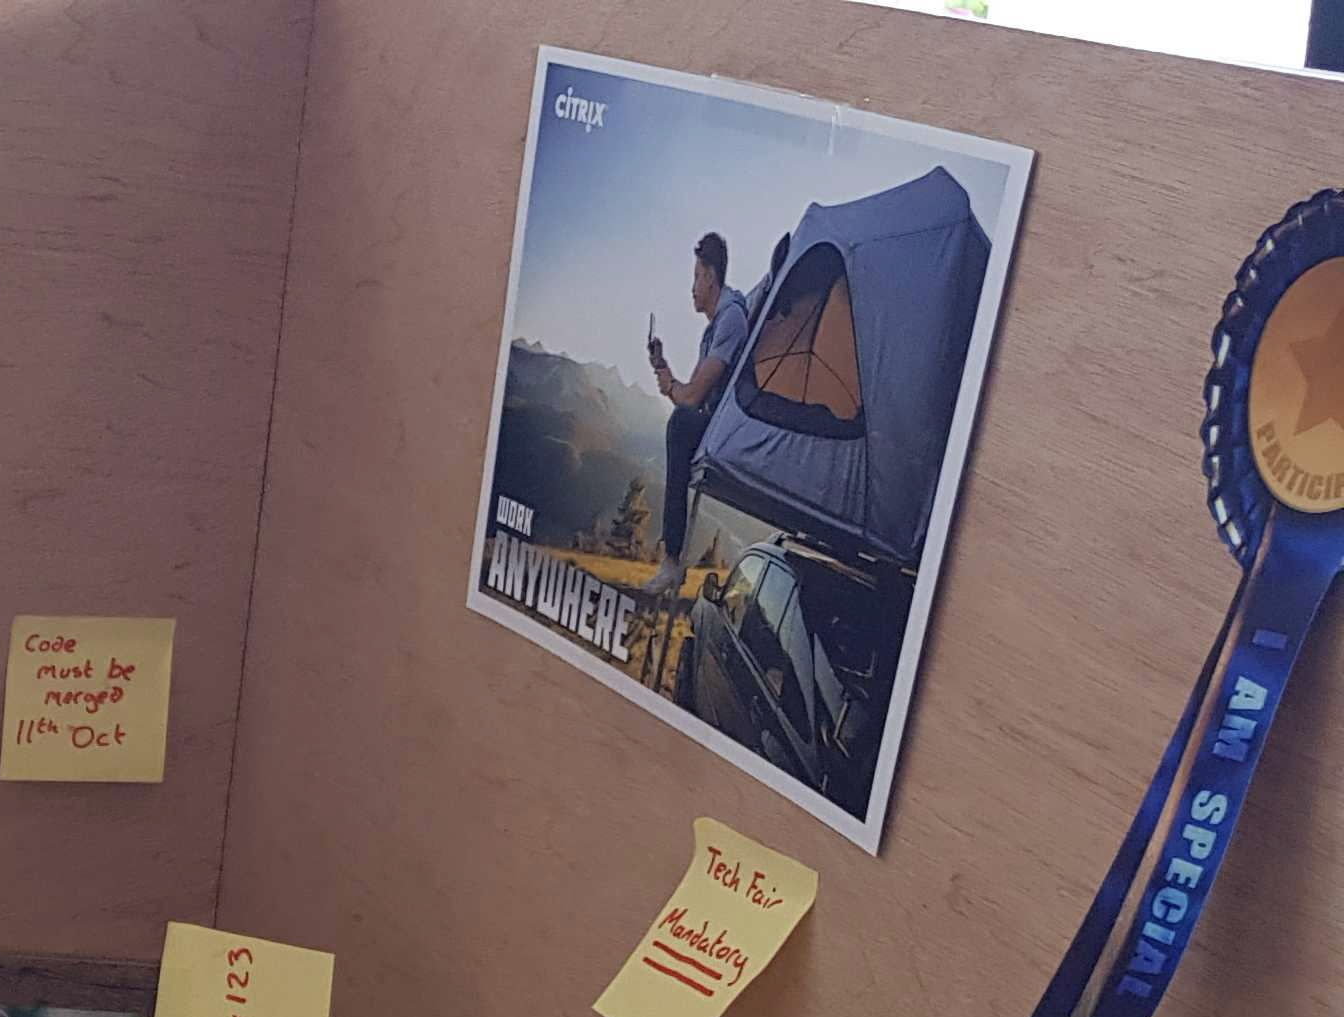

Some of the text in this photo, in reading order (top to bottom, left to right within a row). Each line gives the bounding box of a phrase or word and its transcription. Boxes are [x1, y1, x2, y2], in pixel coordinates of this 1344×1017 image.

[496, 495, 535, 537] WORK
[487, 530, 637, 663] ANYWHERE
[25, 634, 77, 653] Code
[36, 657, 136, 681] must be
[70, 723, 126, 748] Oct
[1117, 629, 1288, 998] I AM SPECIAL
[706, 846, 783, 910] Tech Fair
[658, 907, 749, 987] Mandatory
